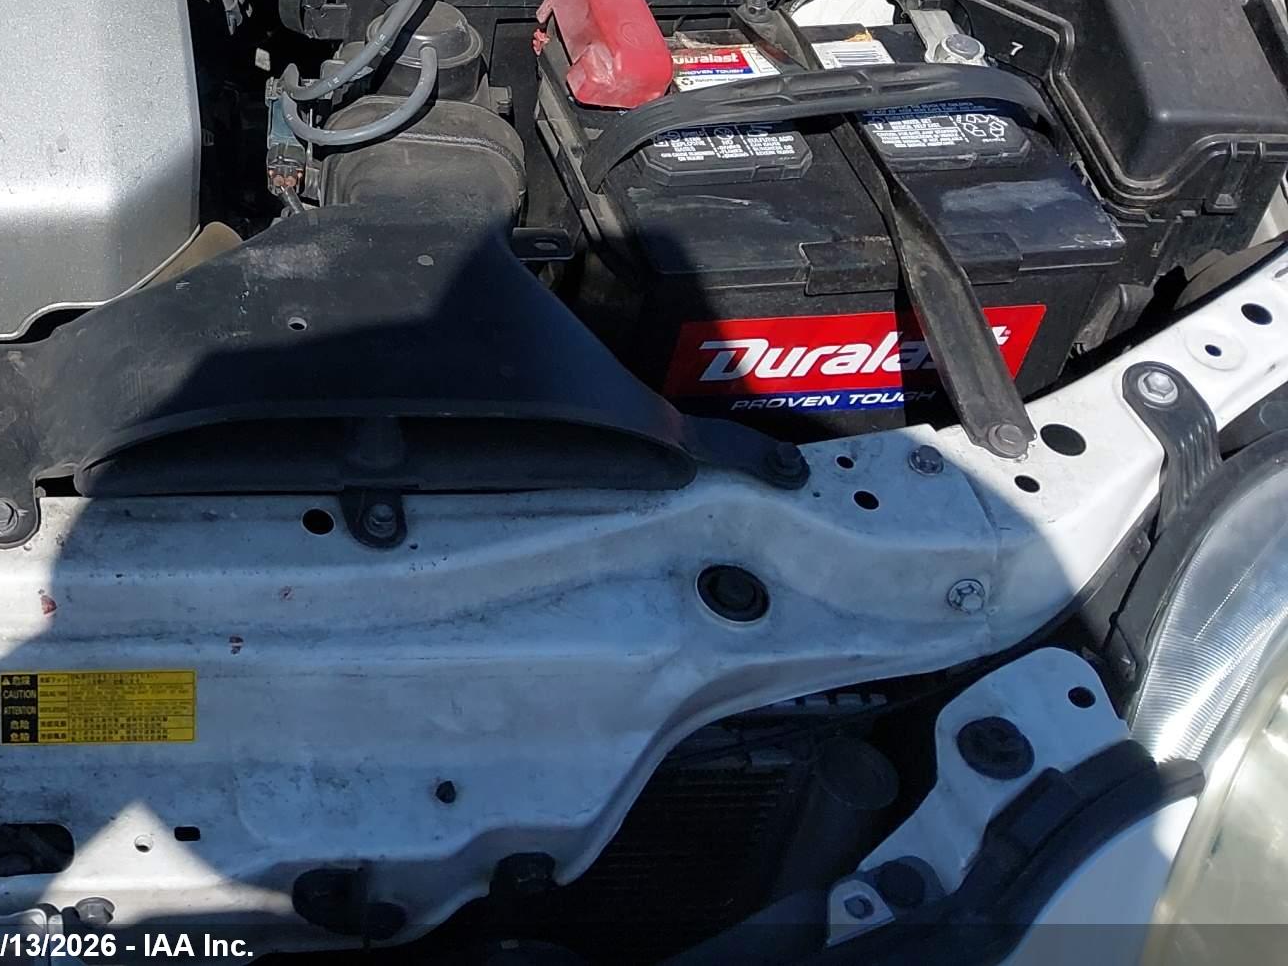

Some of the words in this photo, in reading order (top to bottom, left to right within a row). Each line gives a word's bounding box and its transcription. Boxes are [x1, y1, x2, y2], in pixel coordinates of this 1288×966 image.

[699, 326, 1009, 382] Durala
[731, 395, 837, 411] PROVEN
[2, 689, 37, 699] CAUTION
[3, 705, 37, 715] ATTENTION
